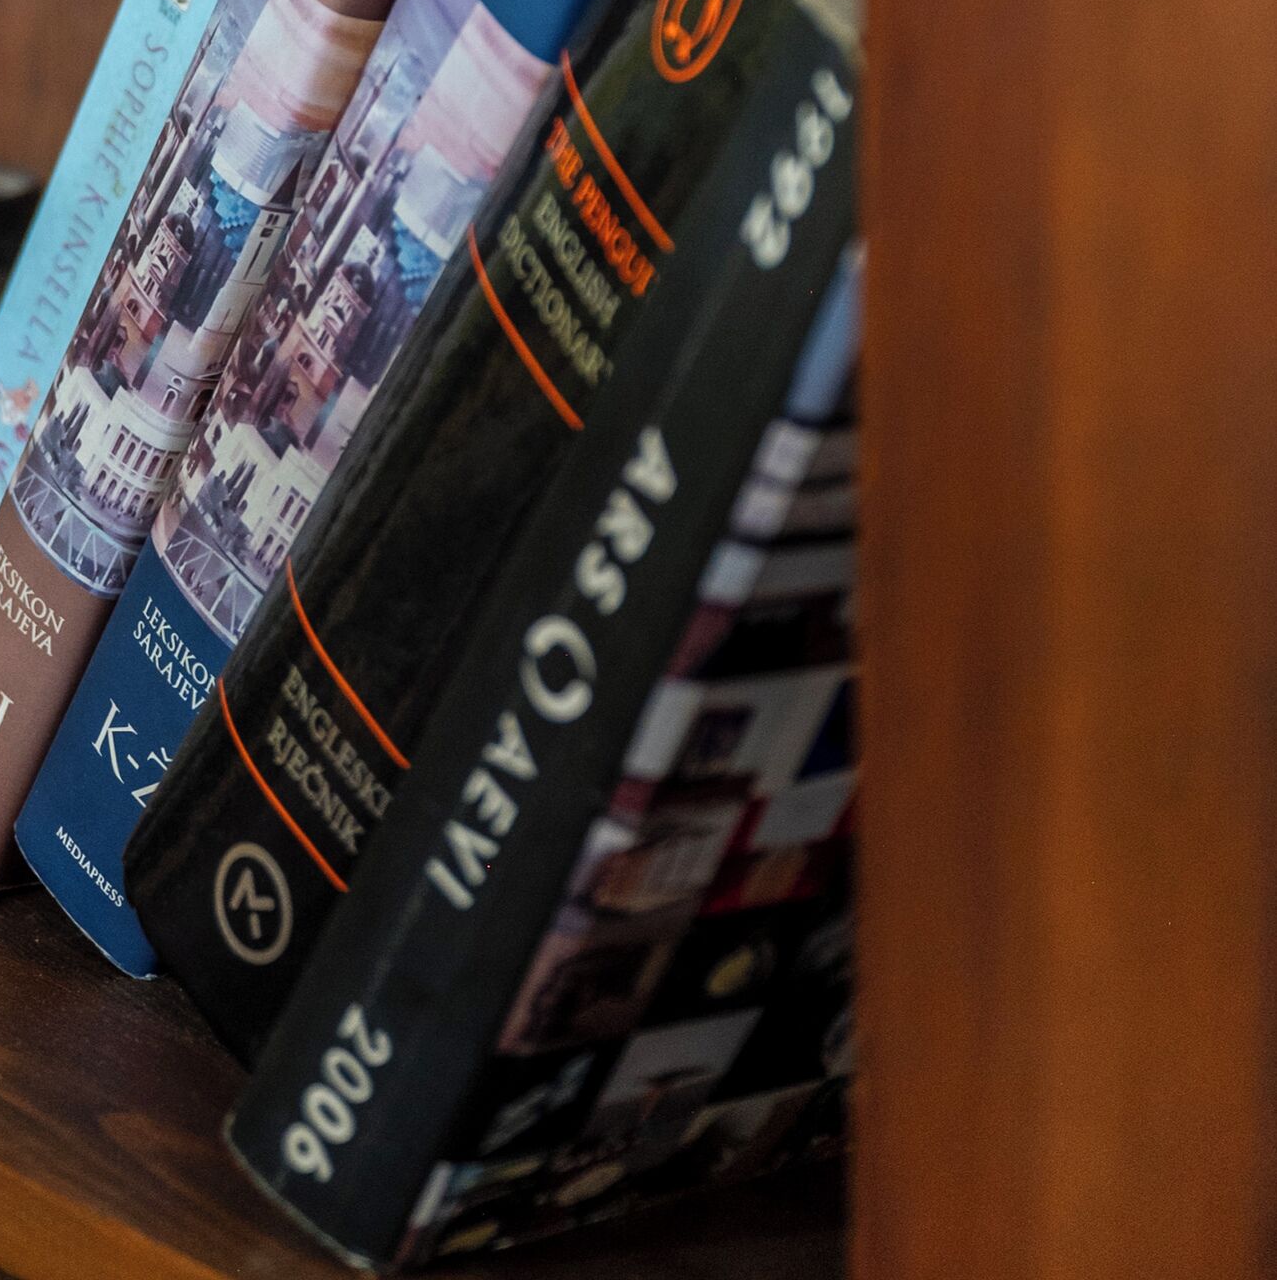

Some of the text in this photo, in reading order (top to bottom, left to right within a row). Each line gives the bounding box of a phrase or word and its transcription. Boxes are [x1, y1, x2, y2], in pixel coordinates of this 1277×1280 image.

[18, 32, 169, 365] SOPHIE KINSELLA
[544, 115, 657, 298] THE PENGUI
[739, 65, 854, 271] 1992
[532, 190, 621, 329] ENGLISH
[132, 620, 206, 713] SARAJEV
[281, 663, 394, 820] ENGLESKI
[425, 424, 678, 912] ARS AEVI
[55, 825, 124, 908] MEDIAPRESS
[280, 1003, 394, 1183] 2006
